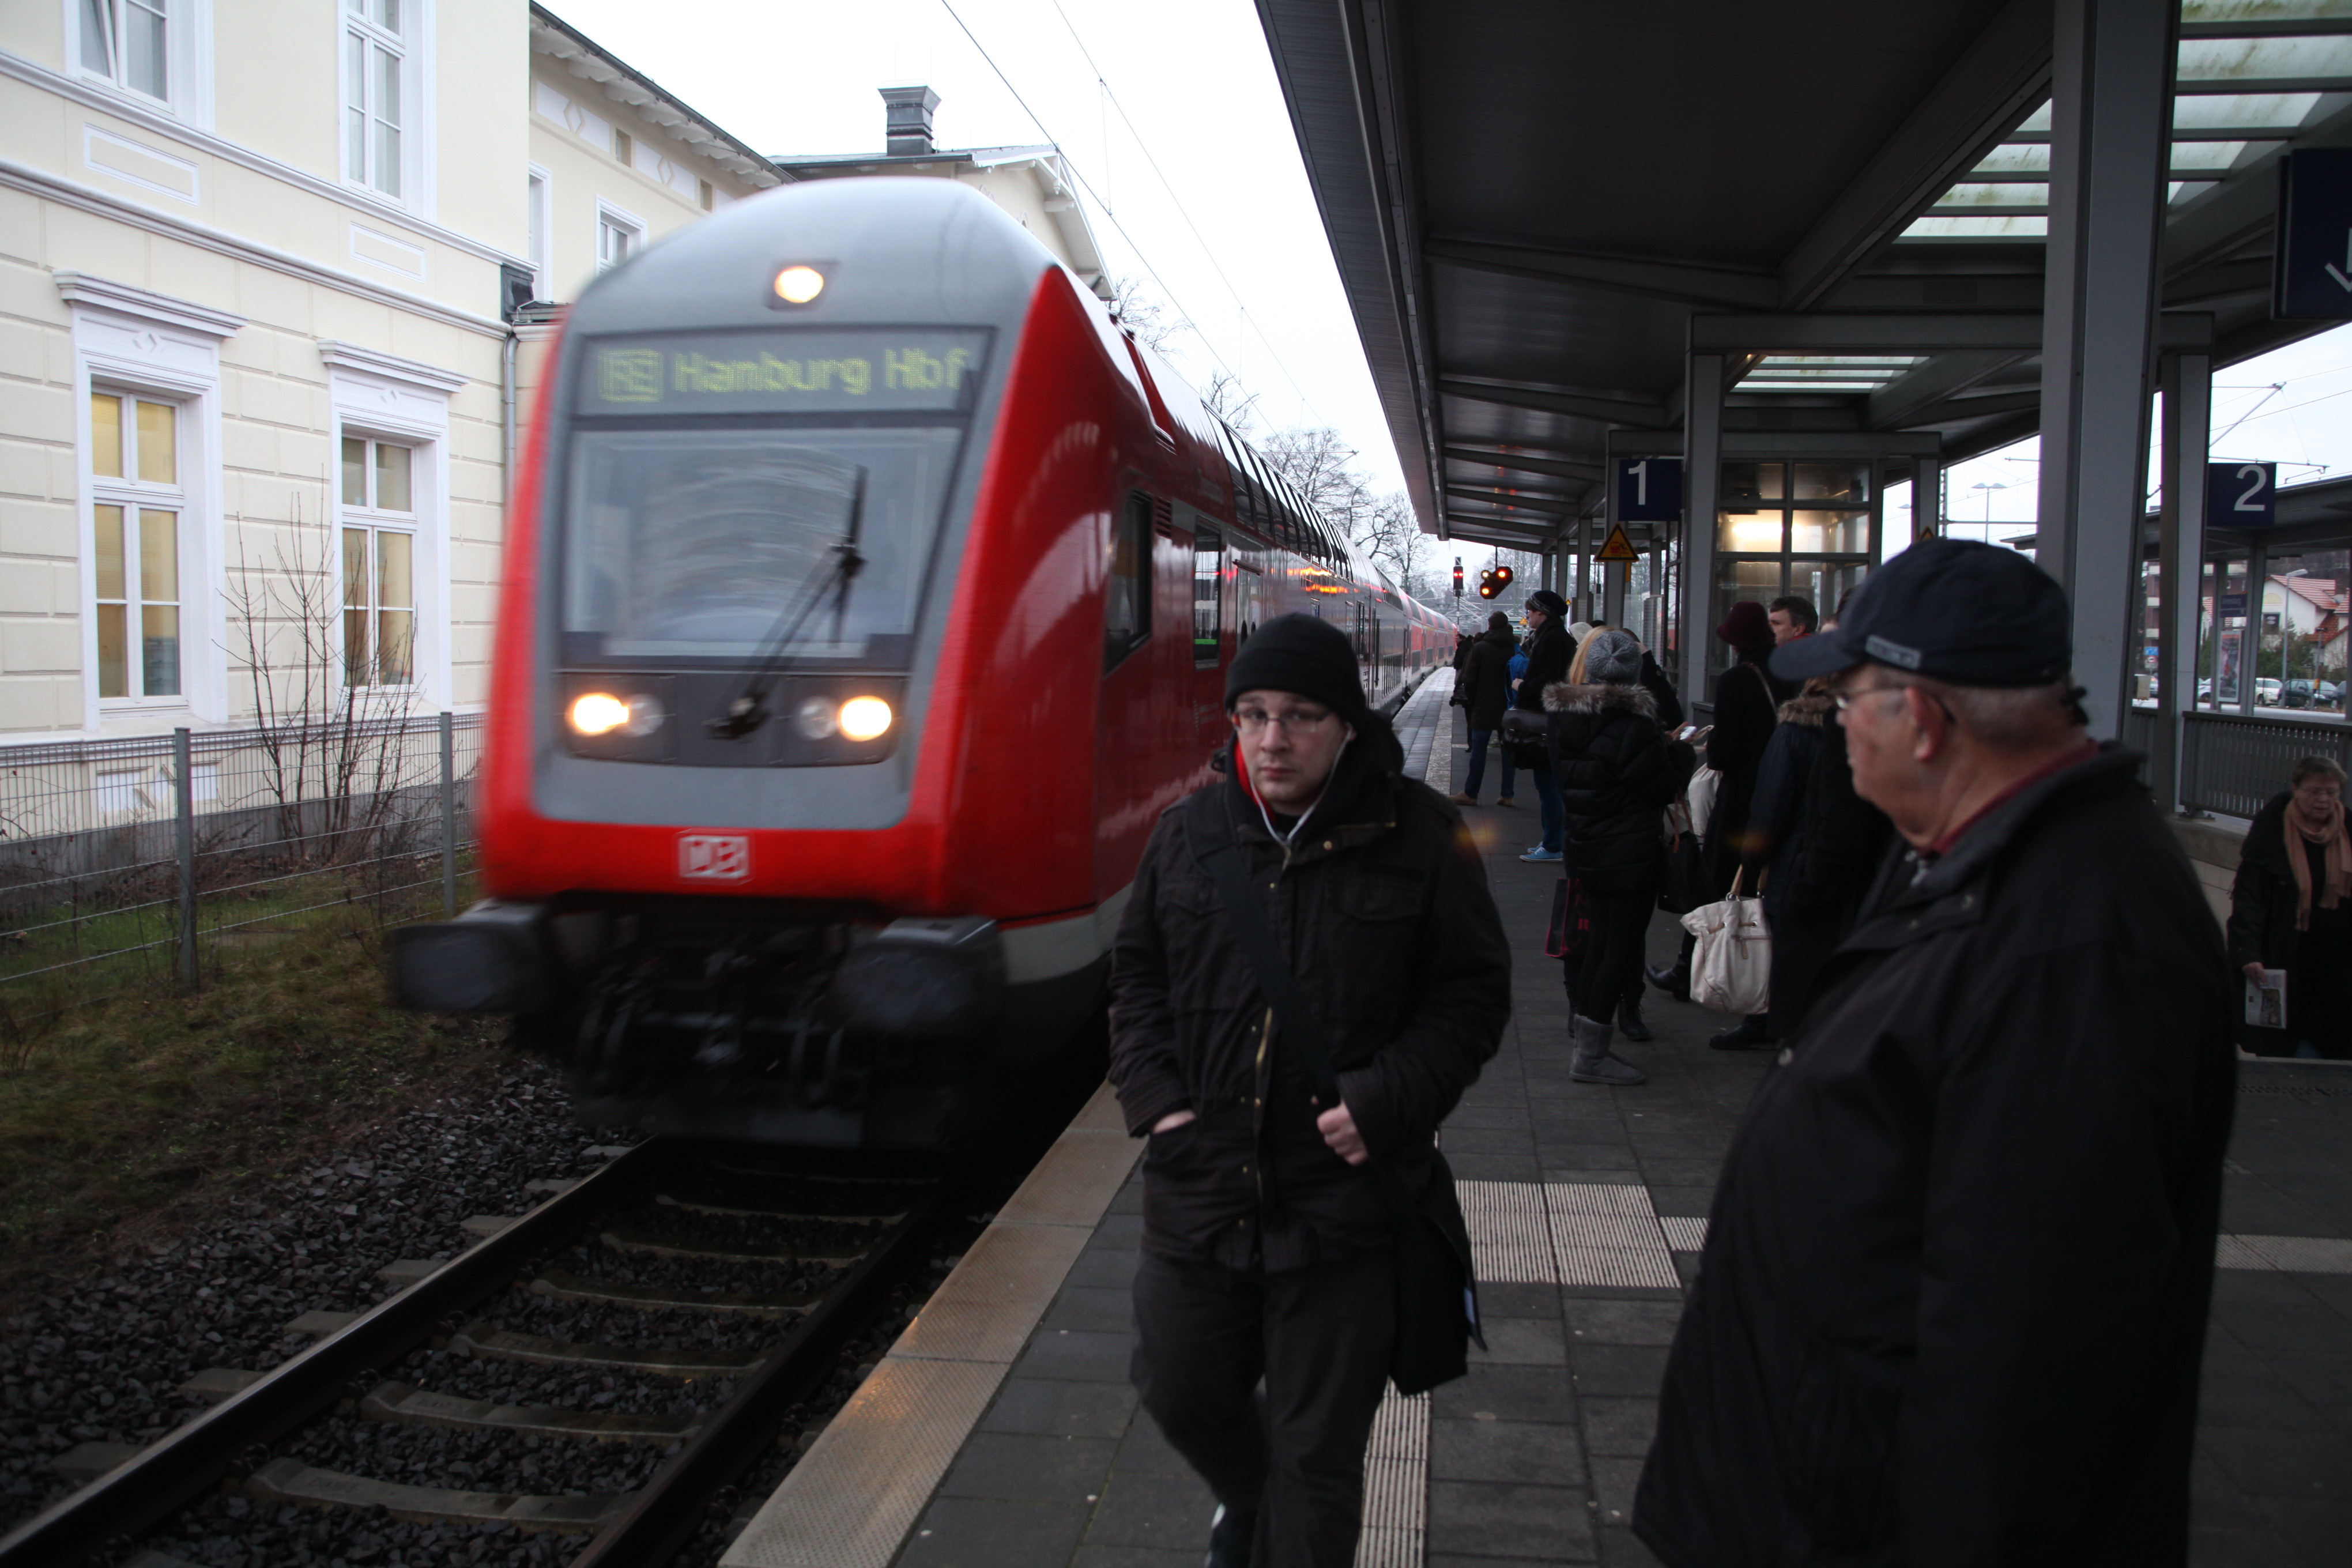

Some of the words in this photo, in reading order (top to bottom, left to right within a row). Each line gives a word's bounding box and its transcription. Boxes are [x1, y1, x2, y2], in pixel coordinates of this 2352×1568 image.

[673, 350, 871, 395] Hamburg
[884, 348, 971, 390] Hbf
[1628, 460, 1646, 506] 1
[2234, 465, 2267, 511] 2
[679, 835, 749, 879] DB
